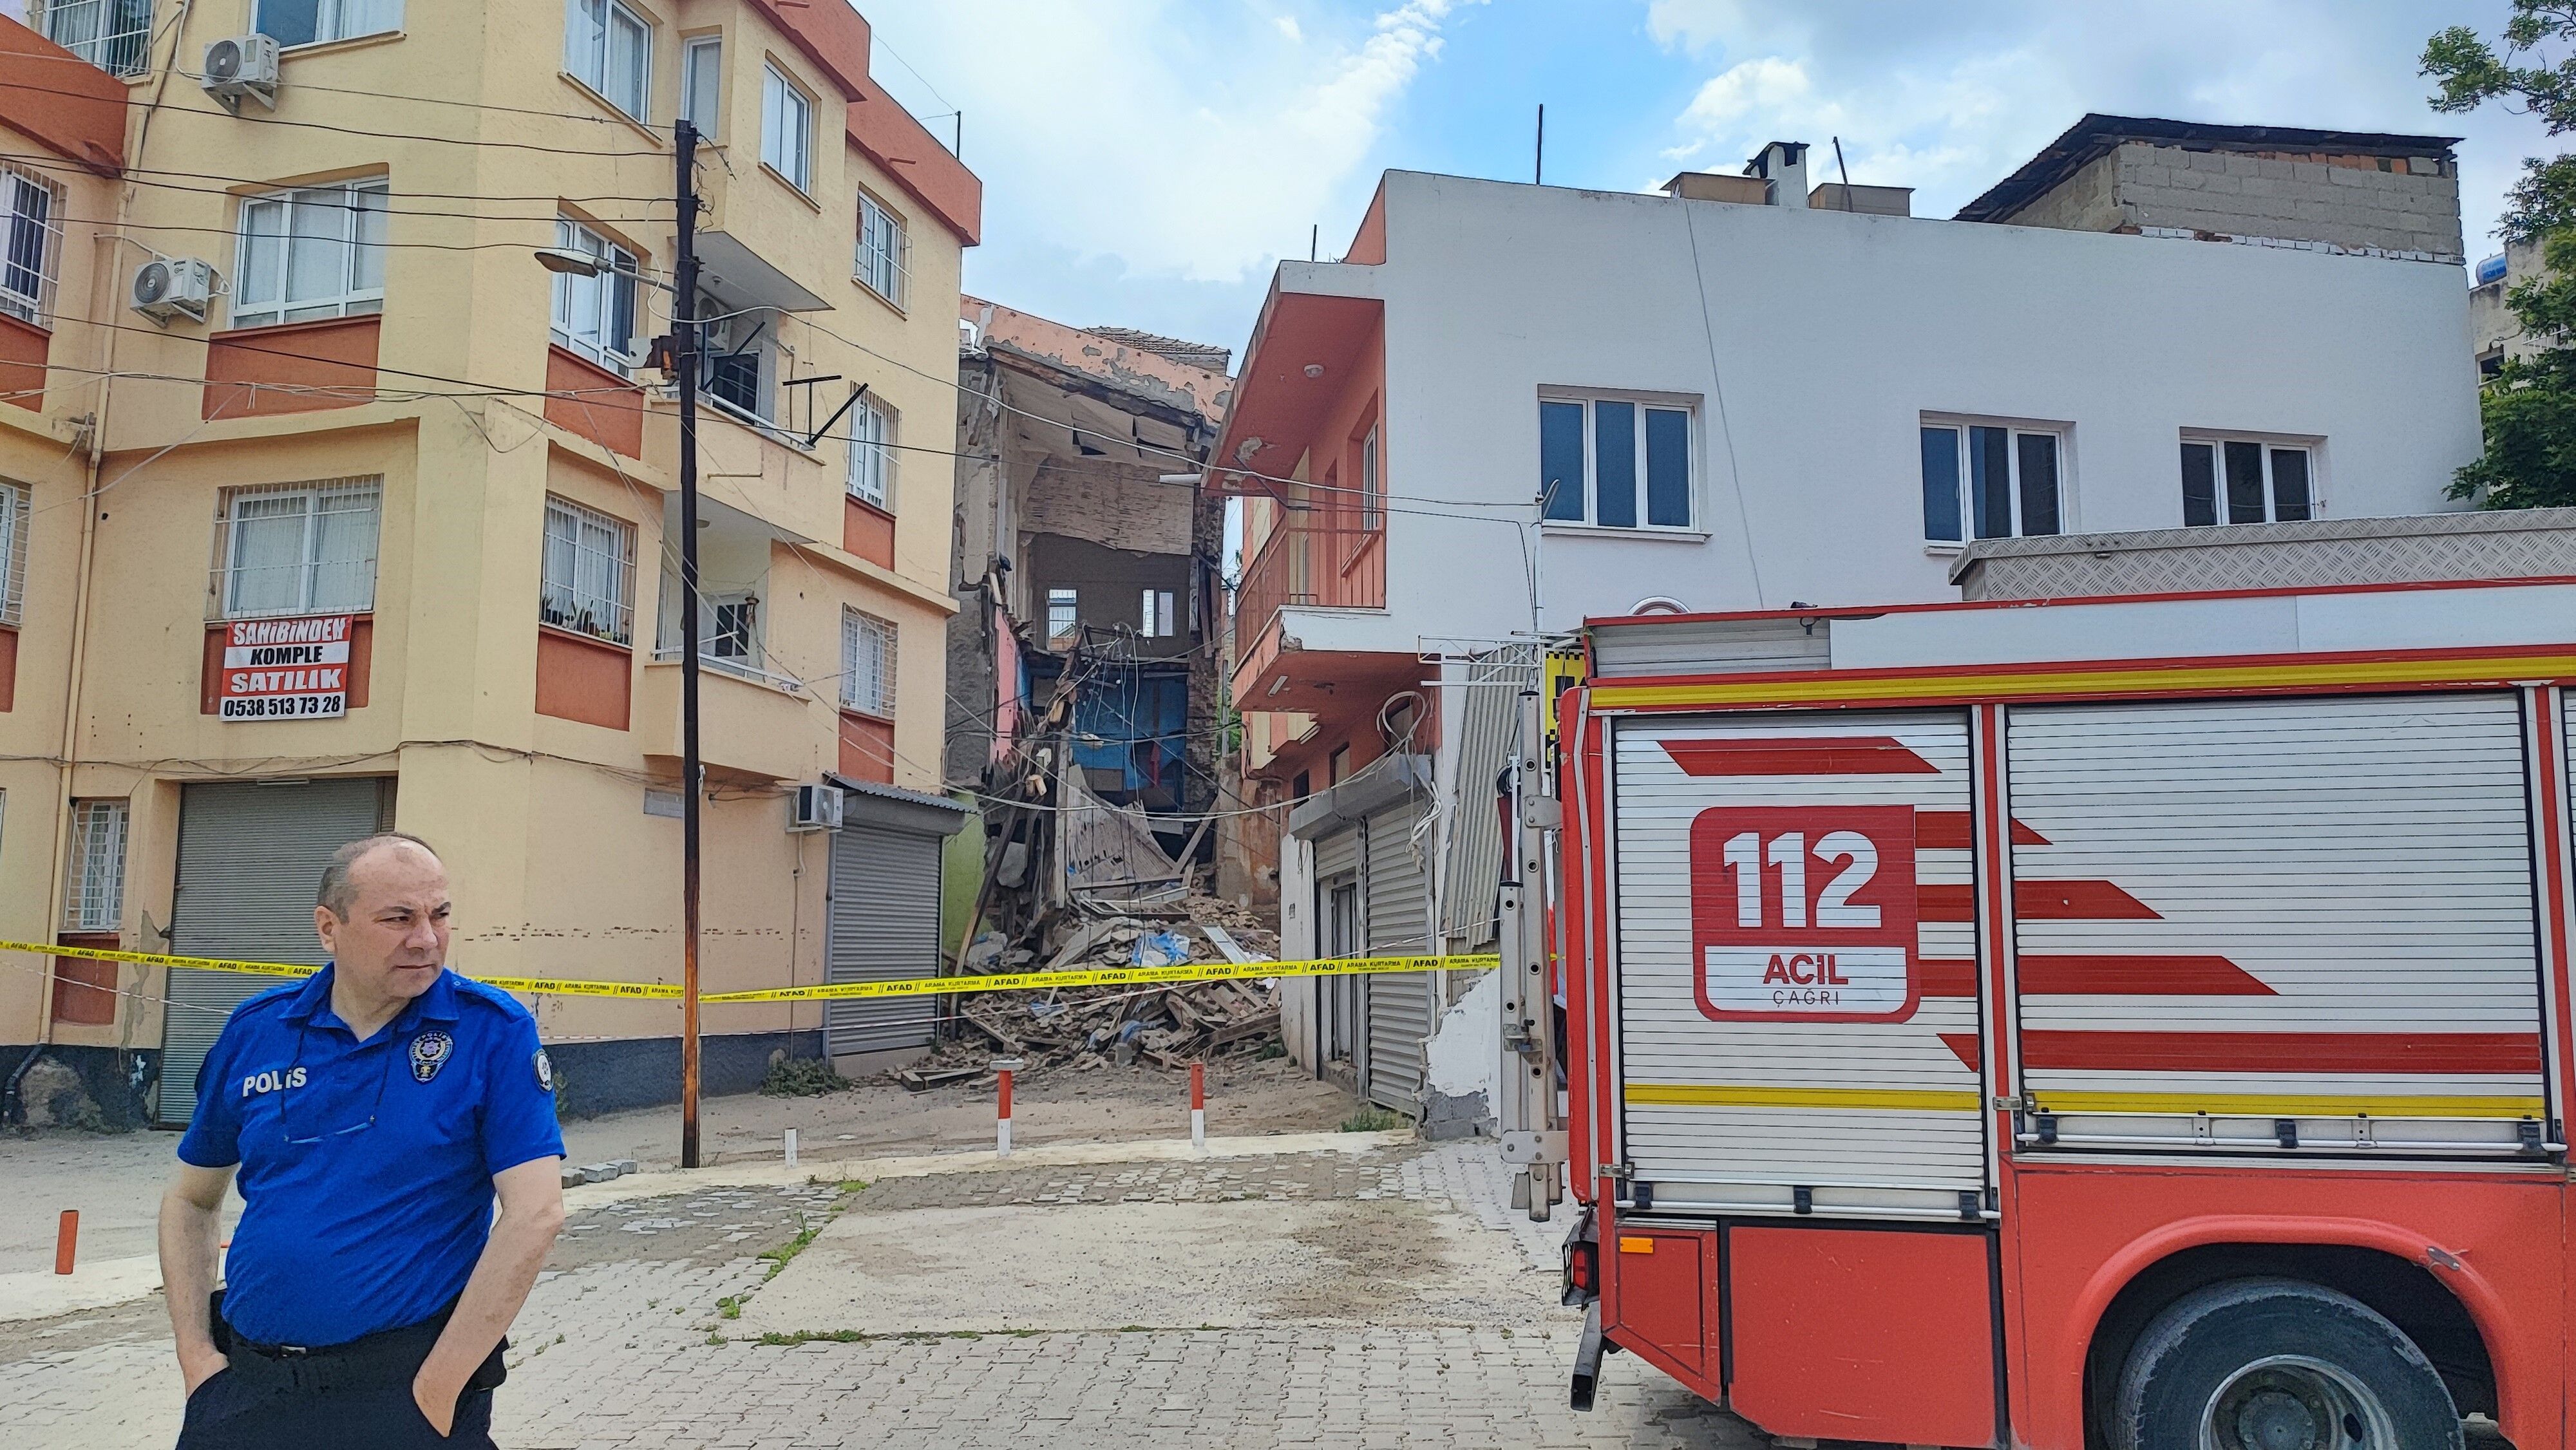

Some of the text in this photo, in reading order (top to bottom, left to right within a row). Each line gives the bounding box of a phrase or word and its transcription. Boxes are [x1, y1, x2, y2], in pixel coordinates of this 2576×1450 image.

[250, 646, 323, 665] KOMPLE
[231, 668, 343, 693] SATILIK
[224, 695, 341, 717] 0538 513 73 28
[1723, 830, 1882, 928] 112
[994, 978, 1019, 986] AFAD
[1413, 959, 1438, 967] AFAD
[1763, 954, 1849, 985] ACİL
[1773, 988, 1839, 1008] ÇAĞRI
